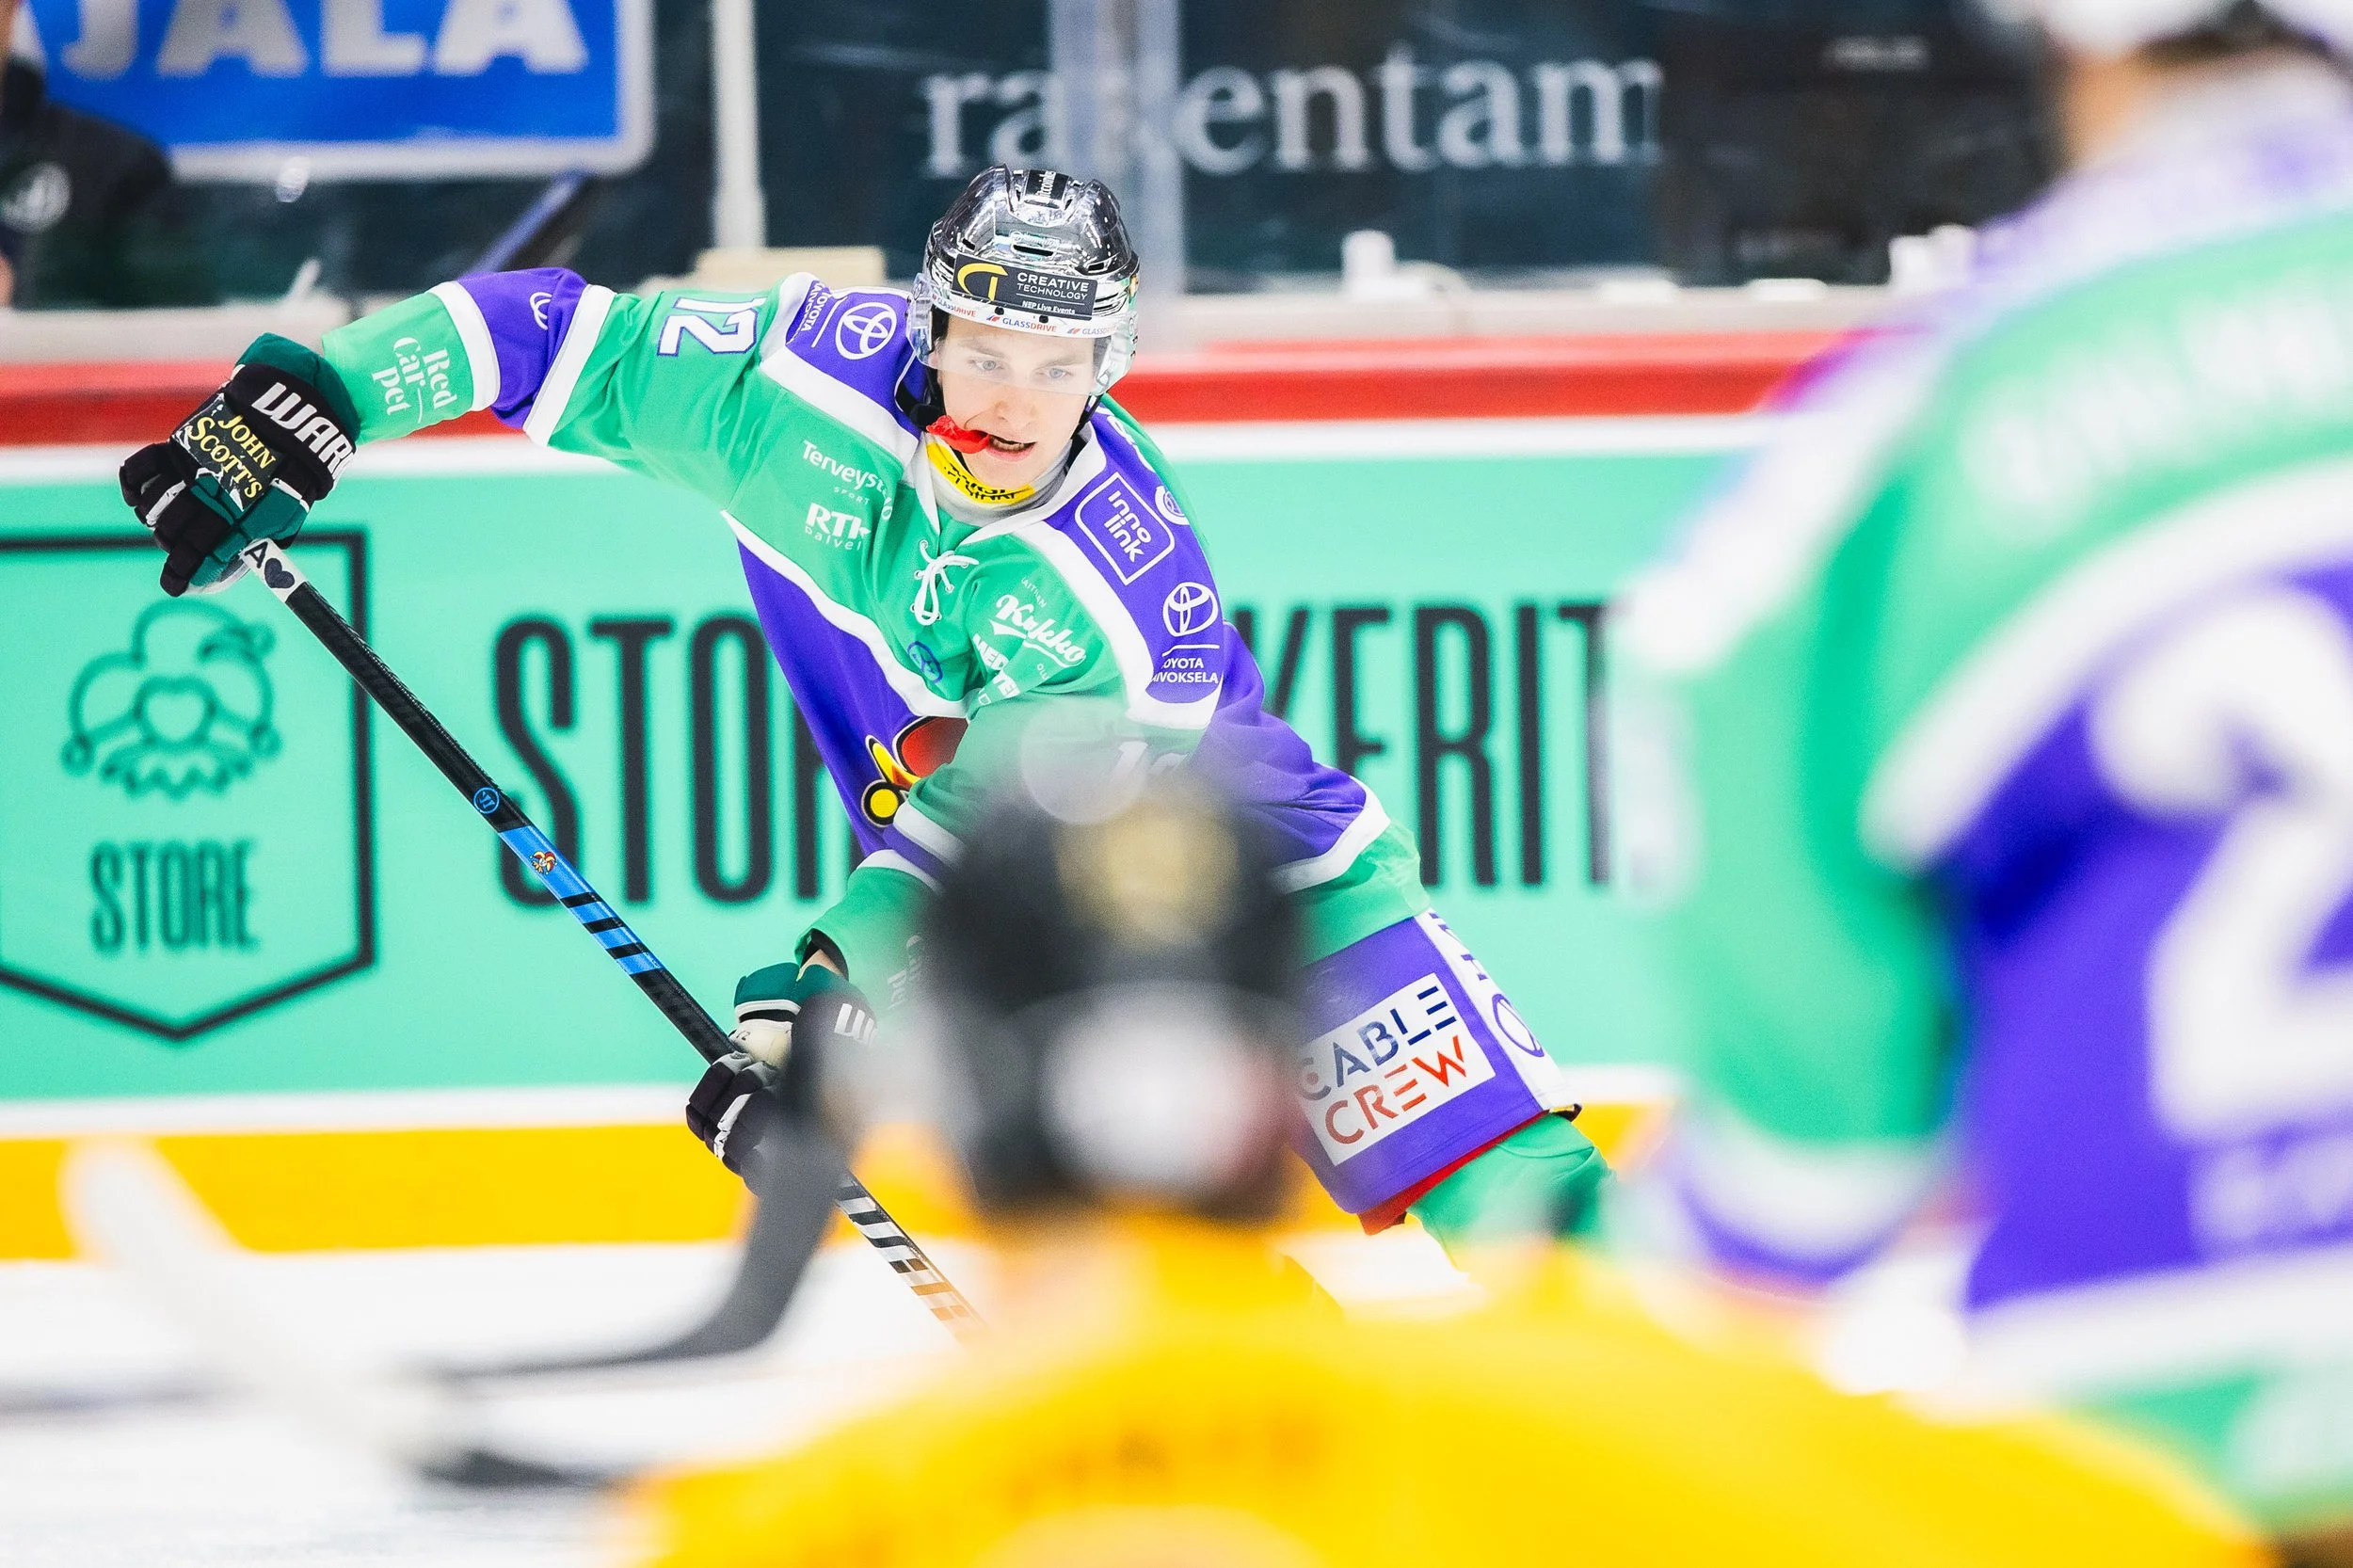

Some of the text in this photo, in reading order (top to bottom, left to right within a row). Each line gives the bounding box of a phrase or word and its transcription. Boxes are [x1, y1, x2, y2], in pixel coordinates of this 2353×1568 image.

[8, 0, 589, 79] JALA
[1017, 272, 1089, 292] CREATIVE
[1017, 283, 1088, 300] TECHNOLOGY
[1037, 303, 1052, 312] Live
[1053, 306, 1076, 315] Events
[657, 296, 767, 357] 12
[1002, 317, 1058, 333] GLASSDRIVE
[372, 365, 412, 416] pet
[424, 347, 457, 409] Red
[188, 416, 264, 499] SCOTT'S
[217, 414, 276, 470] JOHN
[1103, 513, 1144, 563] link
[996, 594, 1087, 663] Kukko
[1161, 658, 1204, 669] OYOTA
[91, 841, 256, 951] STORE
[1301, 985, 1457, 1101] CABLE
[1325, 1035, 1466, 1144] CREW
